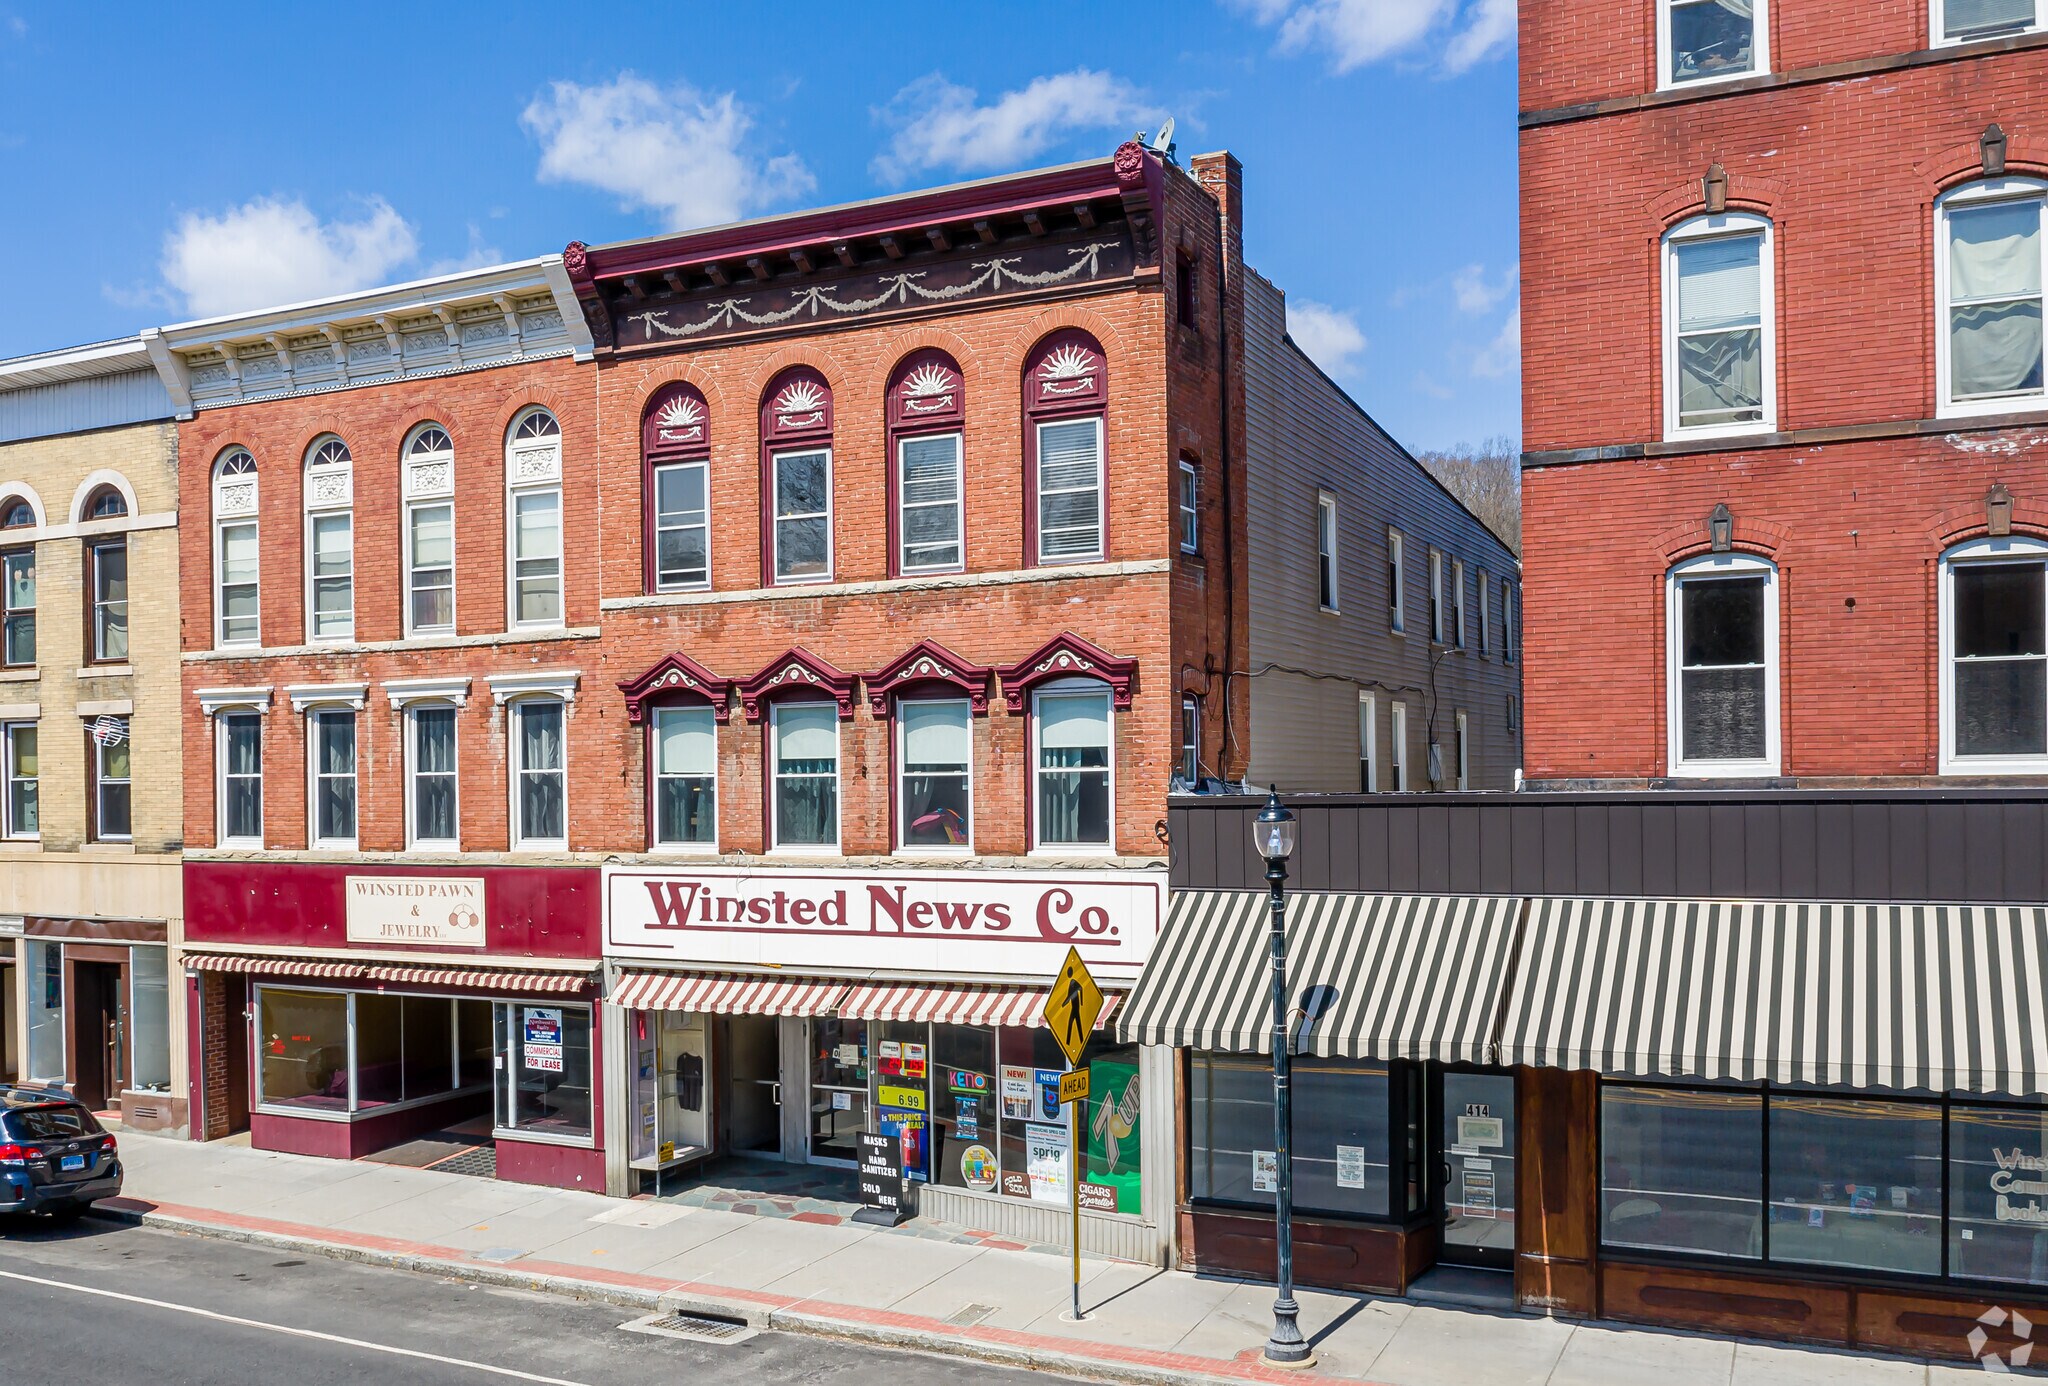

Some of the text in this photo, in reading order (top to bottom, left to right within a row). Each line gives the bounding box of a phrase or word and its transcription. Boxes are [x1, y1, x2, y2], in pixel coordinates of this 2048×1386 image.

[356, 883, 474, 897] WINSTED PAWN
[411, 904, 420, 917] &
[643, 882, 1120, 941] Winsted News Co.
[380, 924, 440, 938] JEWELRY
[526, 1046, 561, 1057] COMMERCIAL
[527, 1058, 561, 1070] FOR LEASE
[1006, 1069, 1027, 1079] NEW!
[1063, 1076, 1087, 1096] AHEAD
[898, 1094, 919, 1107] 6.99
[1467, 1104, 1489, 1117] 414
[888, 1113, 903, 1122] THIS
[903, 1113, 922, 1122] PRICE
[896, 1121, 925, 1130] for REAL?
[863, 1135, 888, 1148] MASKS
[874, 1147, 879, 1155] &
[1033, 1146, 1060, 1163] sprig
[868, 1155, 887, 1166] HAND
[861, 1164, 897, 1178] SANITIZER
[1004, 1175, 1022, 1187] COLD
[862, 1183, 881, 1194] SOLD
[1008, 1183, 1029, 1196] SODA
[1078, 1183, 1111, 1198] CIGARS
[878, 1195, 897, 1207] HERE
